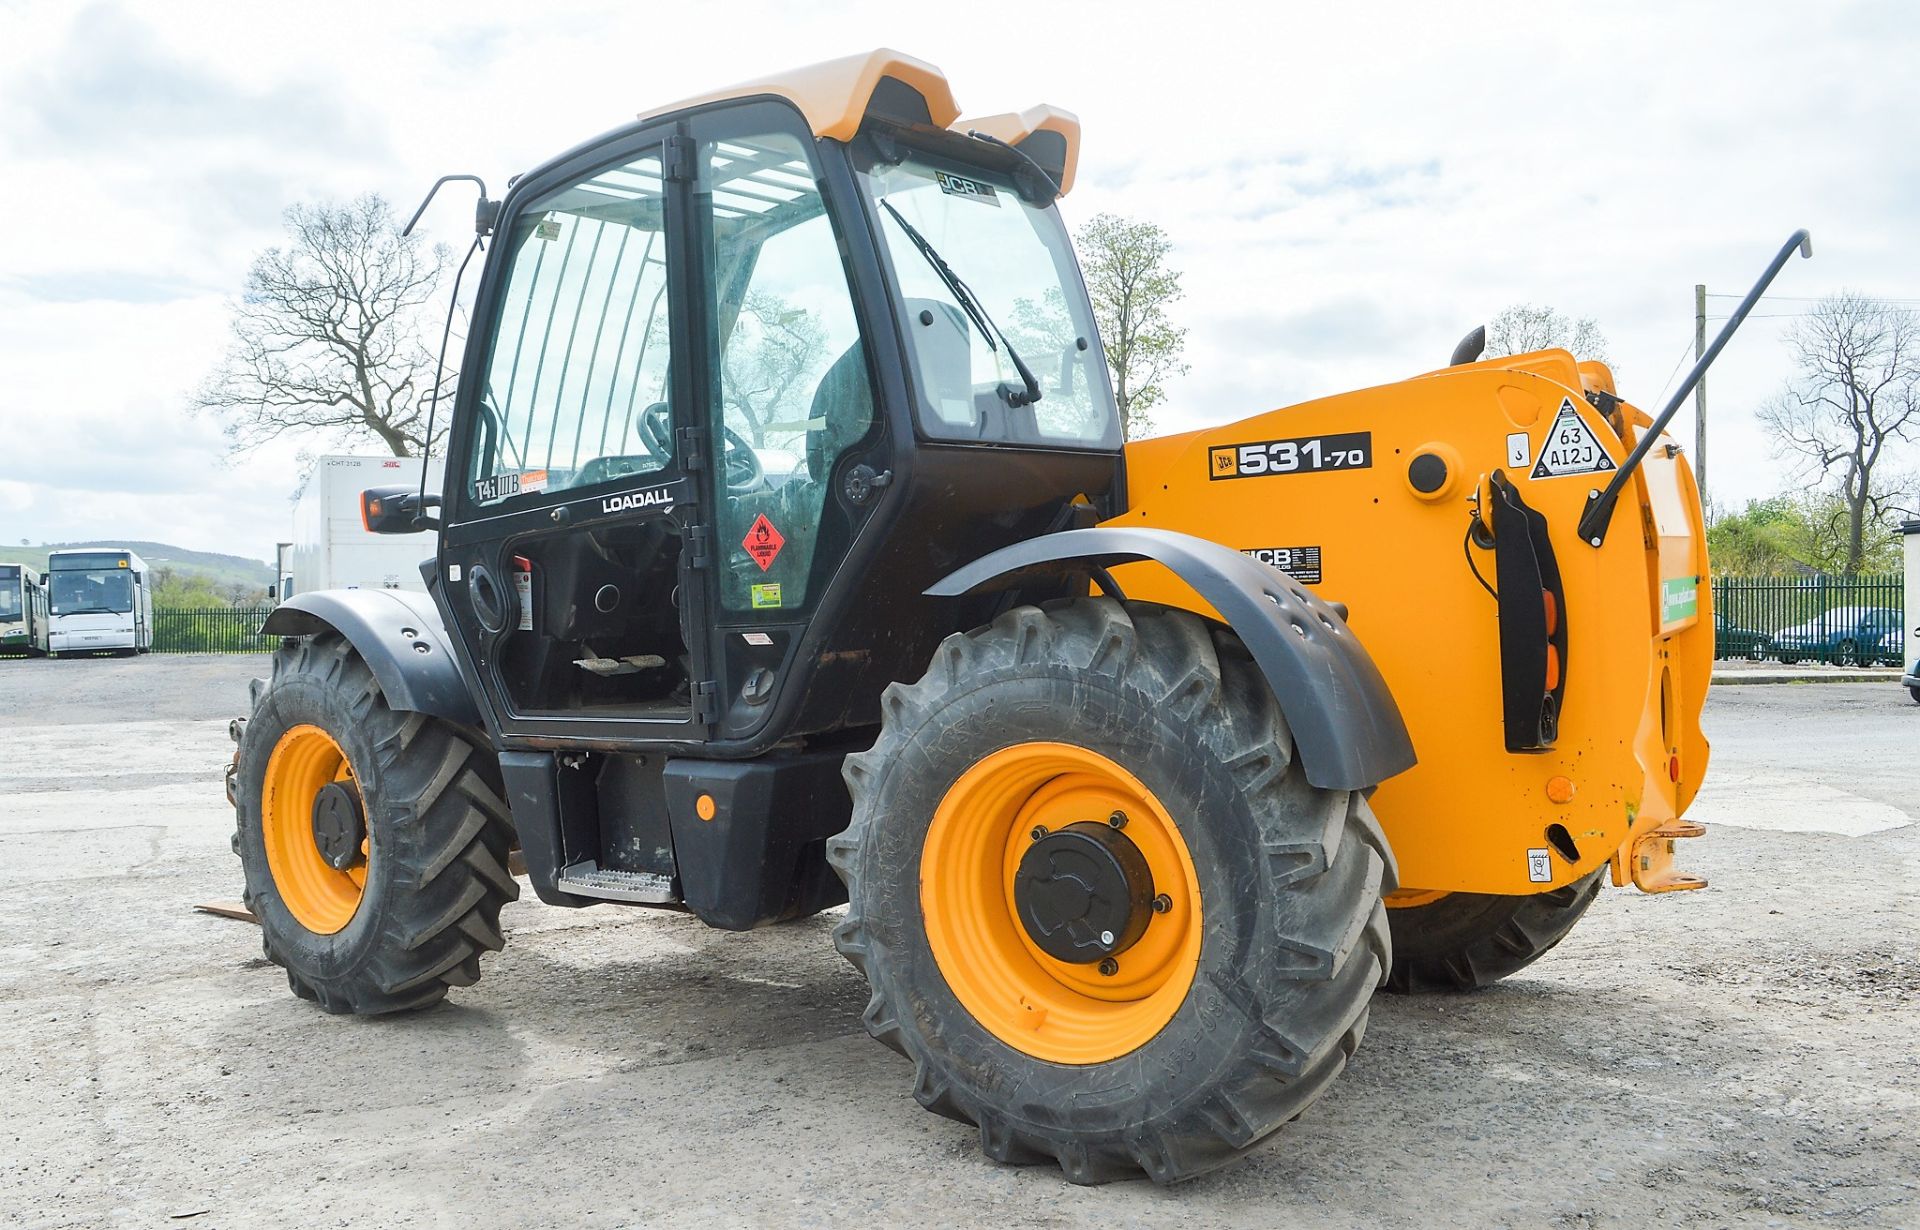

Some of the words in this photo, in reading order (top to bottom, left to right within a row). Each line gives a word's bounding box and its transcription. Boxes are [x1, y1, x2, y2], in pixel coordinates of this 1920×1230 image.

[940, 174, 978, 195] JCB
[1560, 428, 1581, 445] 63
[602, 489, 673, 513] LOADALL
